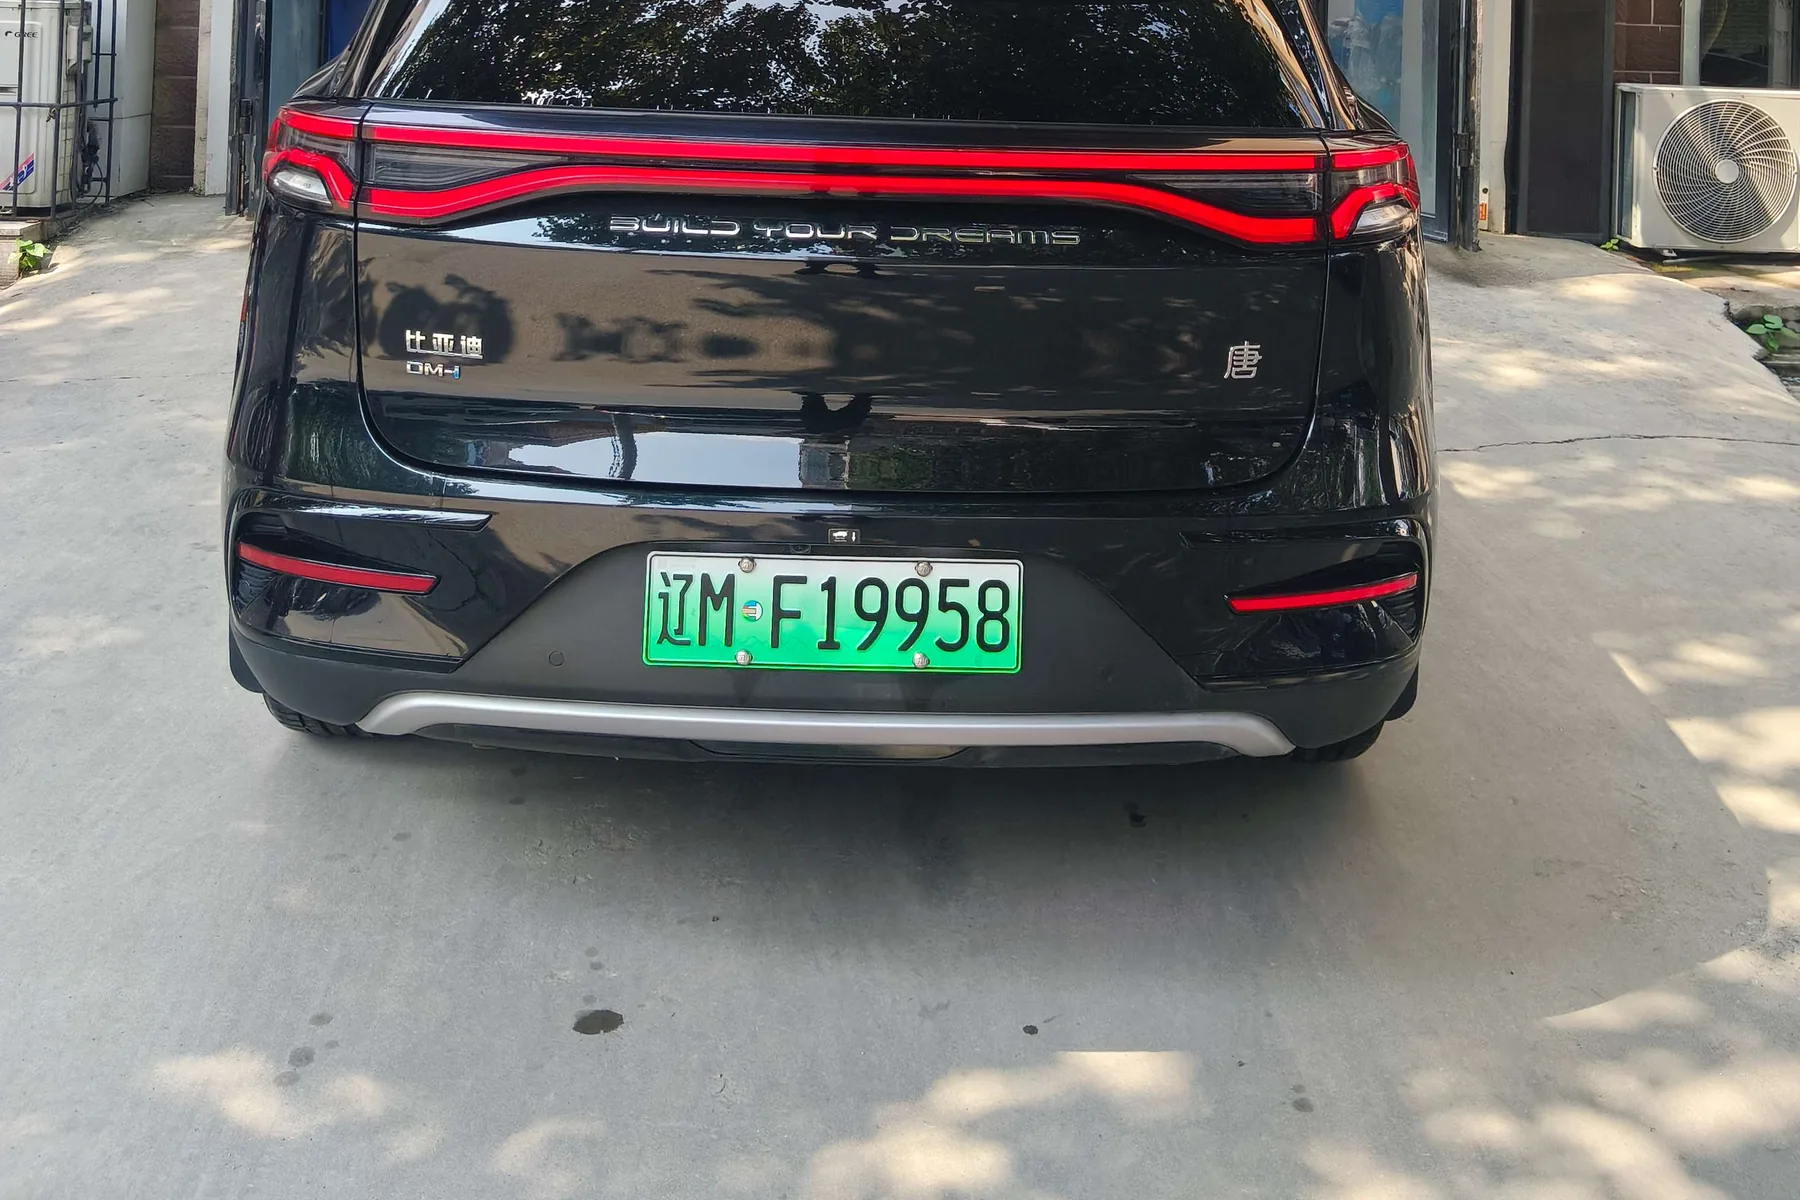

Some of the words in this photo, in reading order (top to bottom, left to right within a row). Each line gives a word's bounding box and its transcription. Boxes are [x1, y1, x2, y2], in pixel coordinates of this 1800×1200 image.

[609, 216, 741, 236] BUILD
[754, 222, 877, 240] YOUR
[890, 225, 1081, 246] DREAMS
[405, 329, 483, 360] 比亚迪
[1223, 340, 1263, 379] 唐
